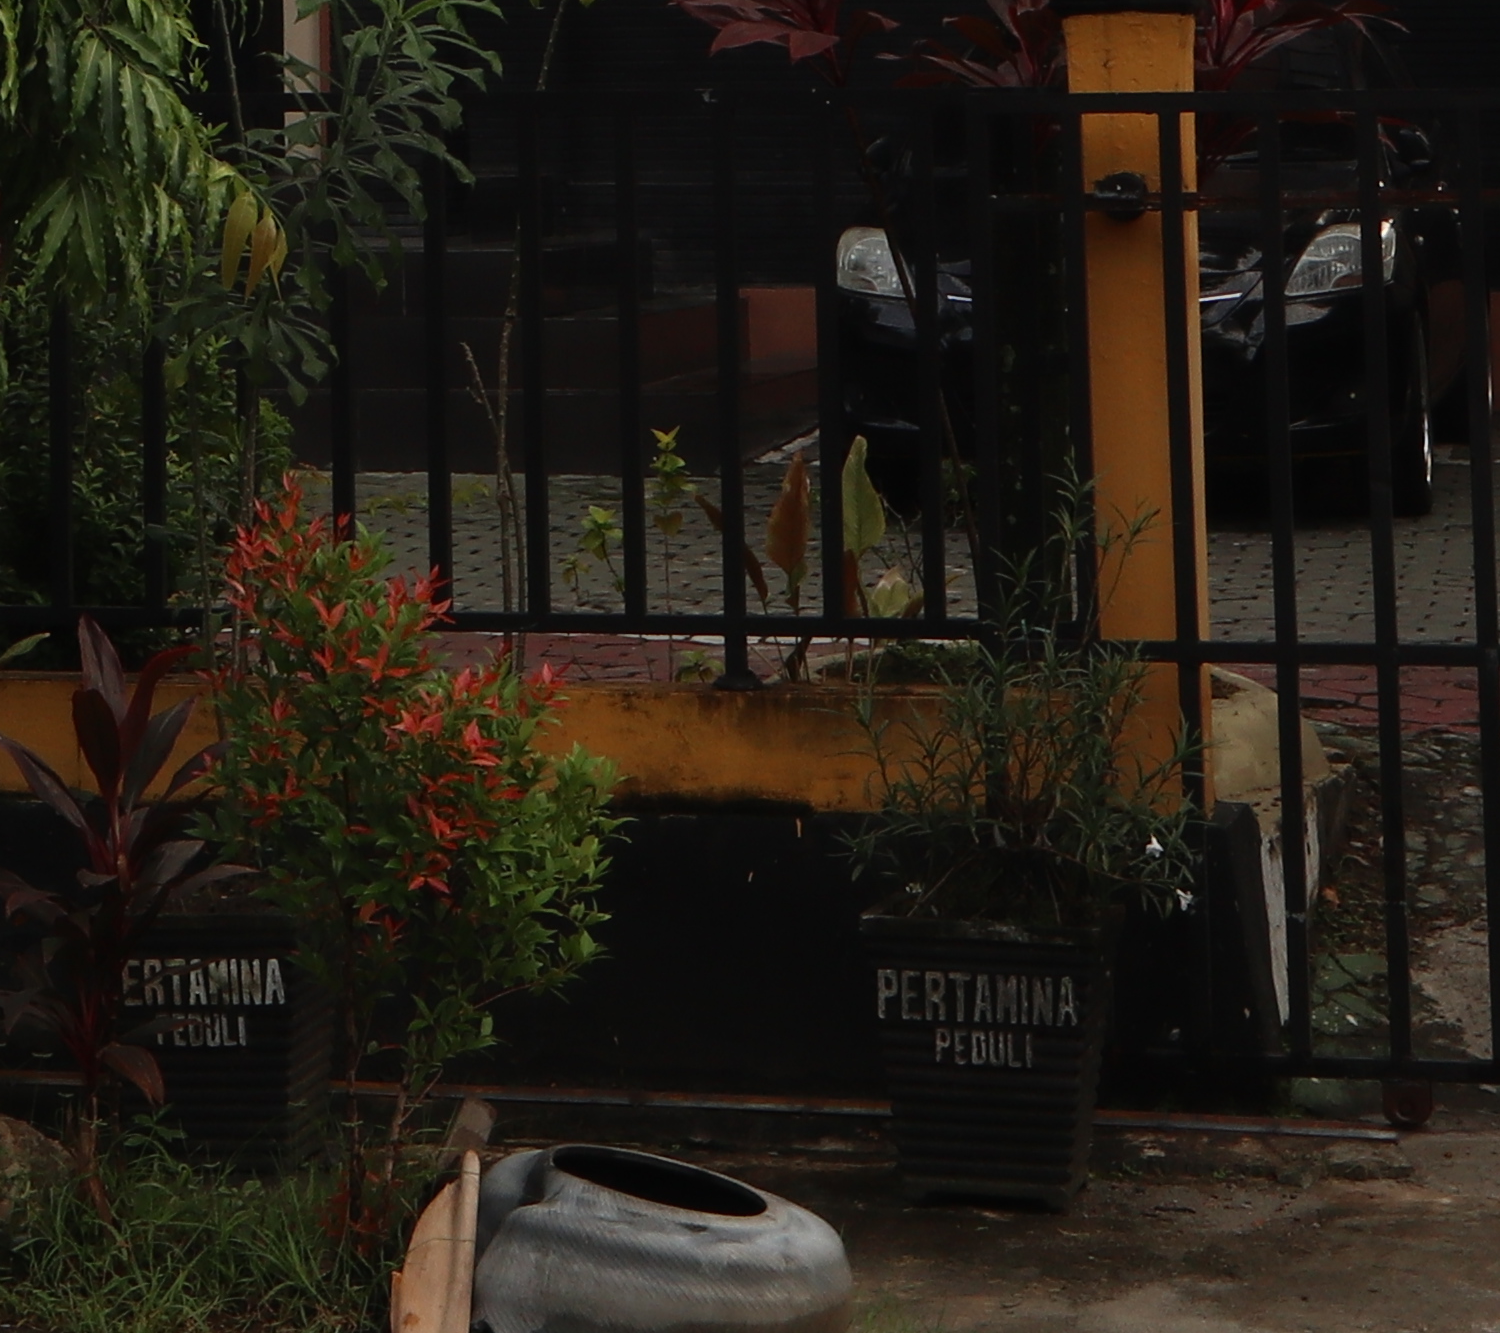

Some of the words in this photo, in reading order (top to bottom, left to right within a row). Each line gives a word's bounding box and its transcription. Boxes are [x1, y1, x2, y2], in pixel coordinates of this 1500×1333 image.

[121, 957, 286, 1007] ERTAMINA
[877, 968, 1080, 1028] PERTAMINA
[935, 1027, 1035, 1069] PEDULI
